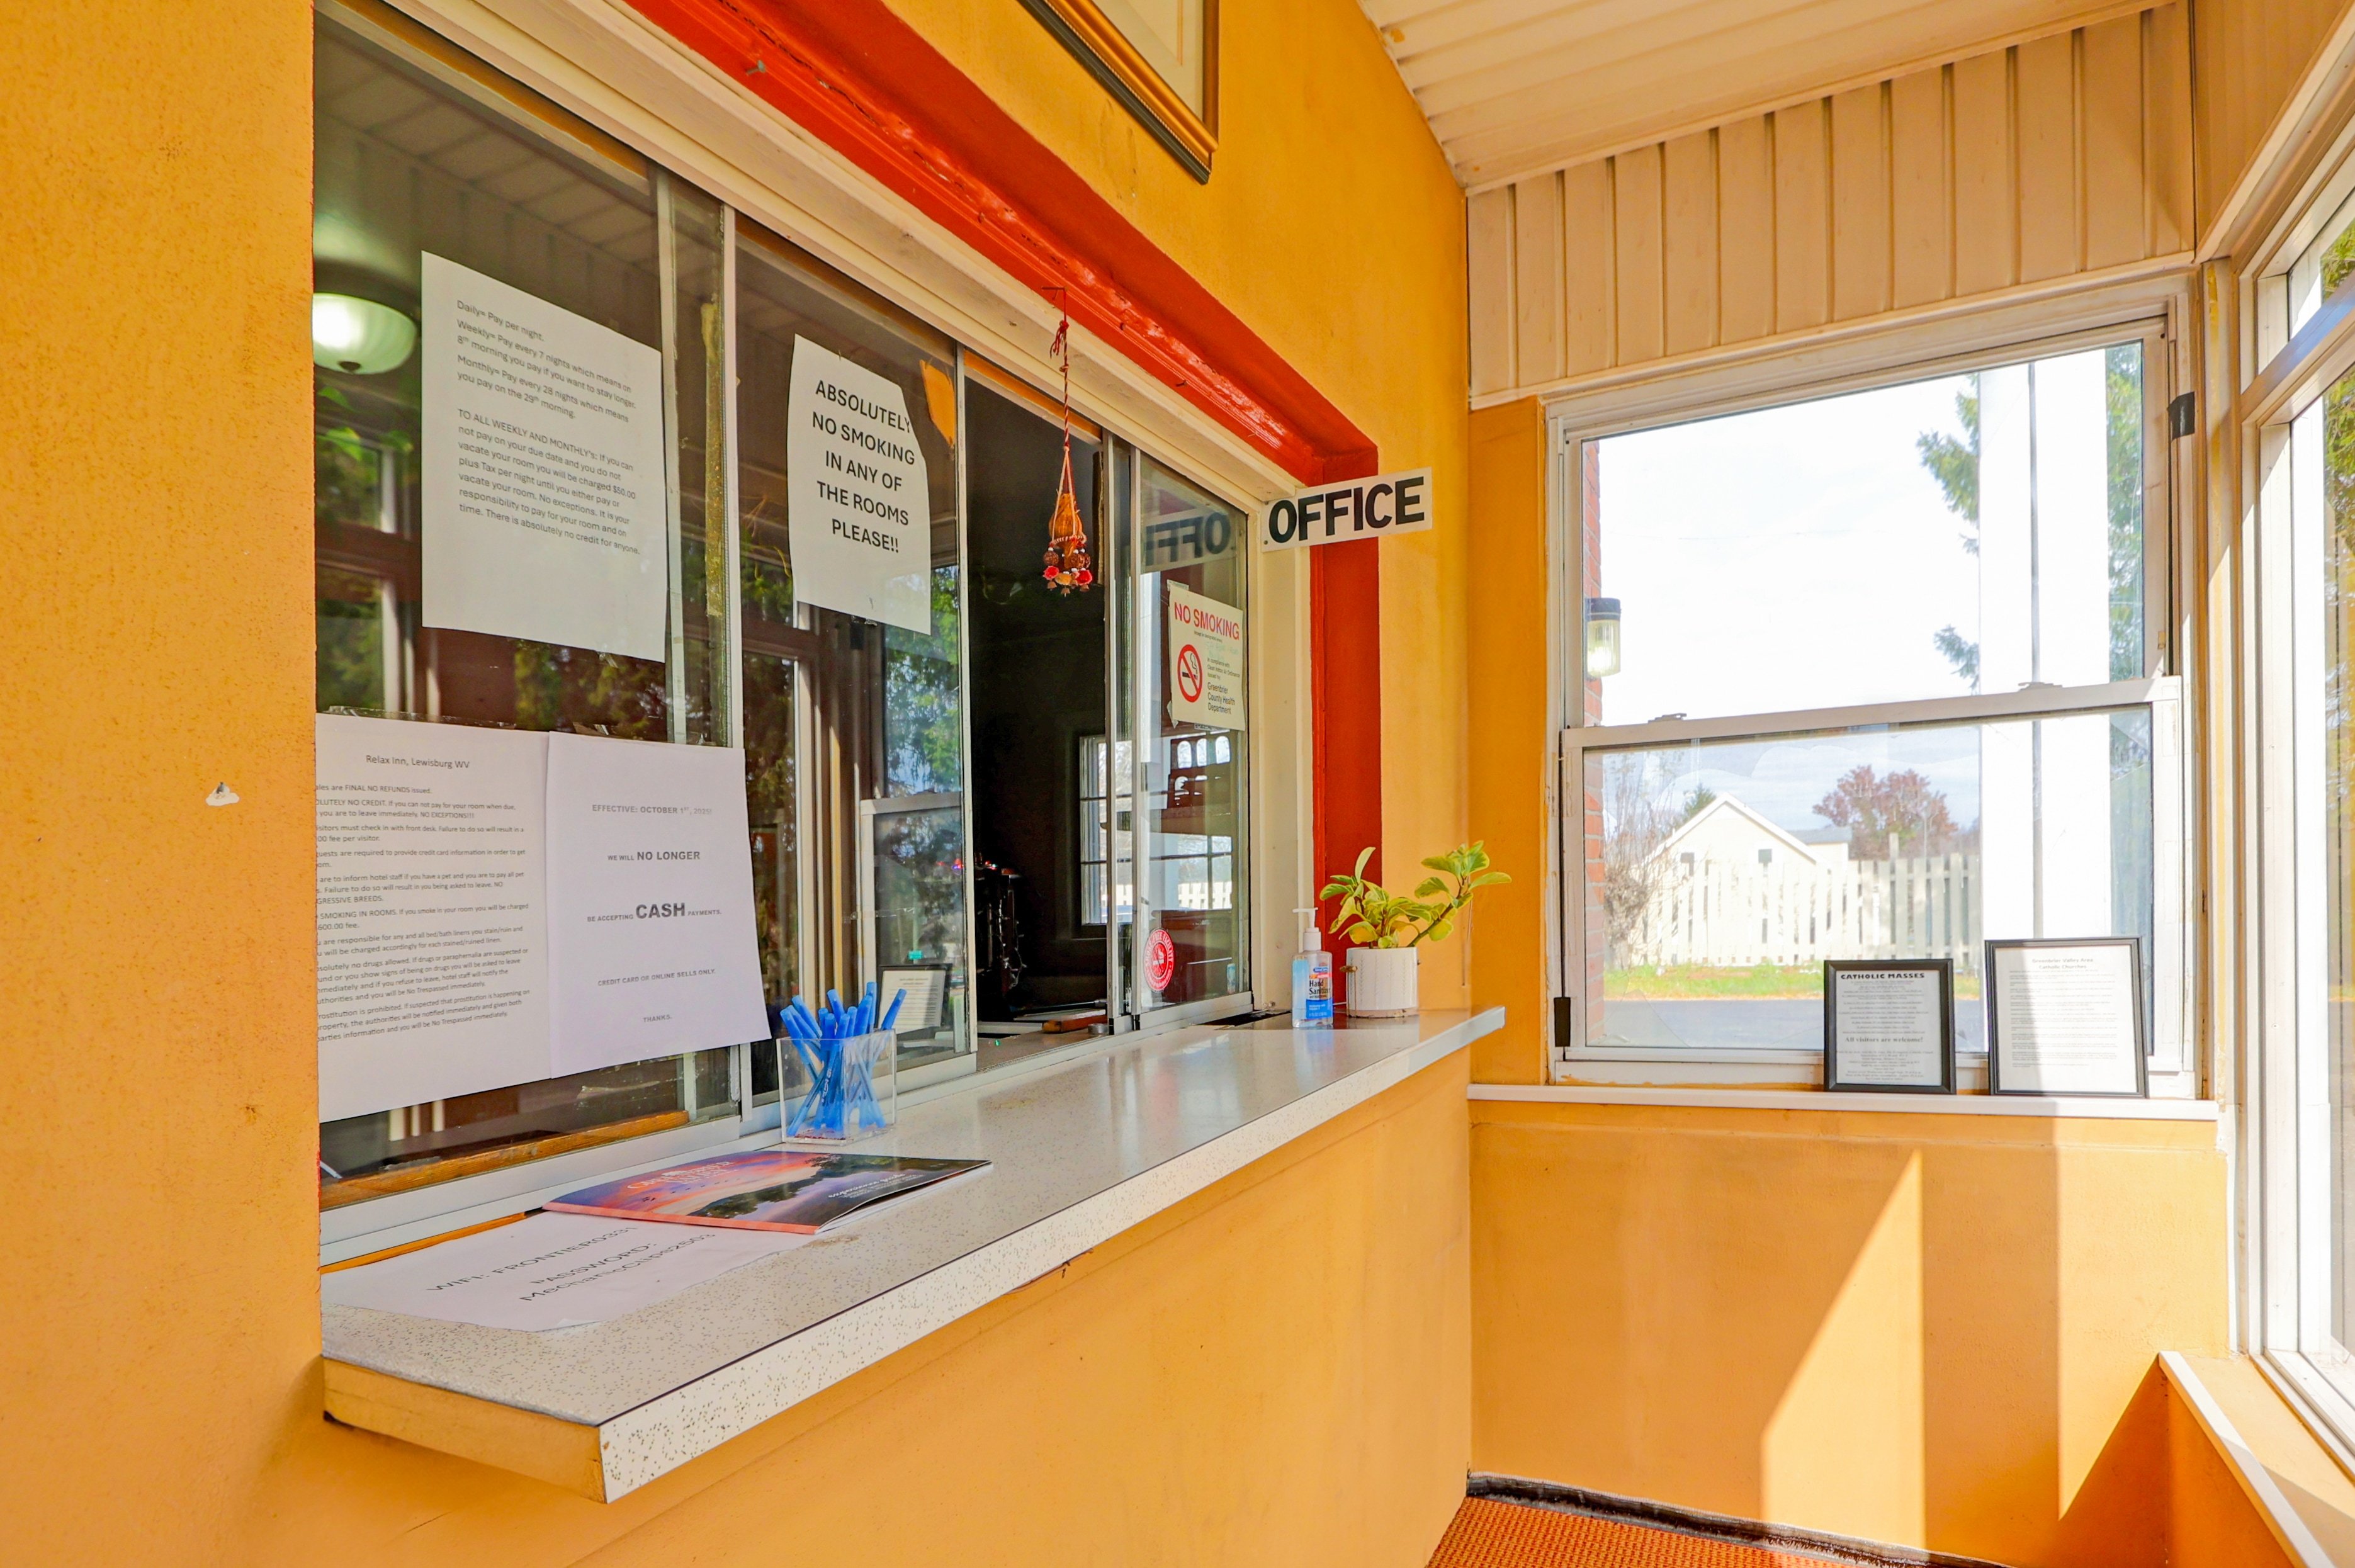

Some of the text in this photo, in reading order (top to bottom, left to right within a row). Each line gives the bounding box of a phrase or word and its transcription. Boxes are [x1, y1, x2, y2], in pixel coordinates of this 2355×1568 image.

[488, 312, 504, 327] Pay
[505, 320, 519, 331] per
[471, 341, 509, 363] morning
[508, 355, 525, 367] you
[526, 362, 542, 375] pay
[543, 367, 550, 376] if
[550, 371, 565, 382] you
[566, 377, 585, 390] want
[586, 383, 595, 393] to
[596, 388, 613, 400] stay
[497, 334, 514, 349] Pay
[514, 342, 538, 358] every
[538, 350, 545, 359] 7
[546, 354, 571, 369] nights
[572, 364, 595, 379] which
[596, 374, 622, 389] means
[622, 385, 631, 393] on
[457, 371, 475, 383] you
[477, 378, 494, 390] pay
[494, 384, 506, 394] on
[507, 388, 522, 400] the
[502, 369, 517, 384] Pay
[519, 378, 541, 393] every
[543, 385, 553, 396] 28
[555, 390, 579, 405] nights
[579, 400, 604, 414] which
[605, 409, 629, 423] means
[815, 380, 910, 433] ABSOLUTELY
[458, 409, 472, 420] TO
[473, 414, 491, 426] ALL
[492, 419, 528, 437] WEEKLY
[529, 431, 548, 444] AND
[599, 453, 606, 462] If
[606, 456, 620, 466] you
[621, 462, 633, 471] can
[813, 412, 915, 465] NO SMOKING
[458, 442, 636, 500] vacate your room you will be charged $50.00
[825, 451, 902, 492] IN ANY OF
[458, 473, 490, 487] vacate
[491, 482, 511, 492] your
[539, 493, 551, 504] No
[599, 509, 606, 518] It
[607, 511, 614, 520] is
[614, 515, 630, 524] your
[459, 489, 519, 511] responsibility
[521, 504, 530, 513] to
[531, 507, 546, 519] pay
[547, 510, 559, 520] for
[560, 515, 577, 525] your
[579, 520, 601, 531] room
[601, 525, 617, 534] and
[816, 480, 908, 525] THE ROOMS
[1268, 476, 1425, 543] OFFICE
[485, 508, 511, 522] There
[511, 515, 519, 525] is
[520, 519, 563, 538] absolutely
[564, 531, 575, 539] no
[575, 534, 599, 544] credit
[601, 538, 613, 546] for
[832, 519, 898, 553] PLEASE!!
[1174, 602, 1191, 624] NO
[1194, 609, 1239, 640] SMOKING
[1207, 682, 1228, 694] Greenbrier
[1208, 692, 1222, 704] County
[1208, 702, 1231, 714] Department
[366, 755, 391, 764] Relax
[411, 757, 453, 770] Lewisburg
[454, 760, 470, 769] WV
[592, 804, 638, 813] EFFECTIVE:
[640, 806, 678, 814] OCTOBER
[636, 851, 653, 861] NO
[656, 850, 701, 860] LONGER
[597, 913, 634, 922] ACCEPTING
[635, 902, 686, 920] CASH
[597, 978, 621, 986] CREDIT
[621, 976, 640, 984] CARD
[651, 972, 675, 980] ONLINE
[1309, 979, 1324, 988] Hand
[531, 1243, 657, 1283] PASSWORD:
